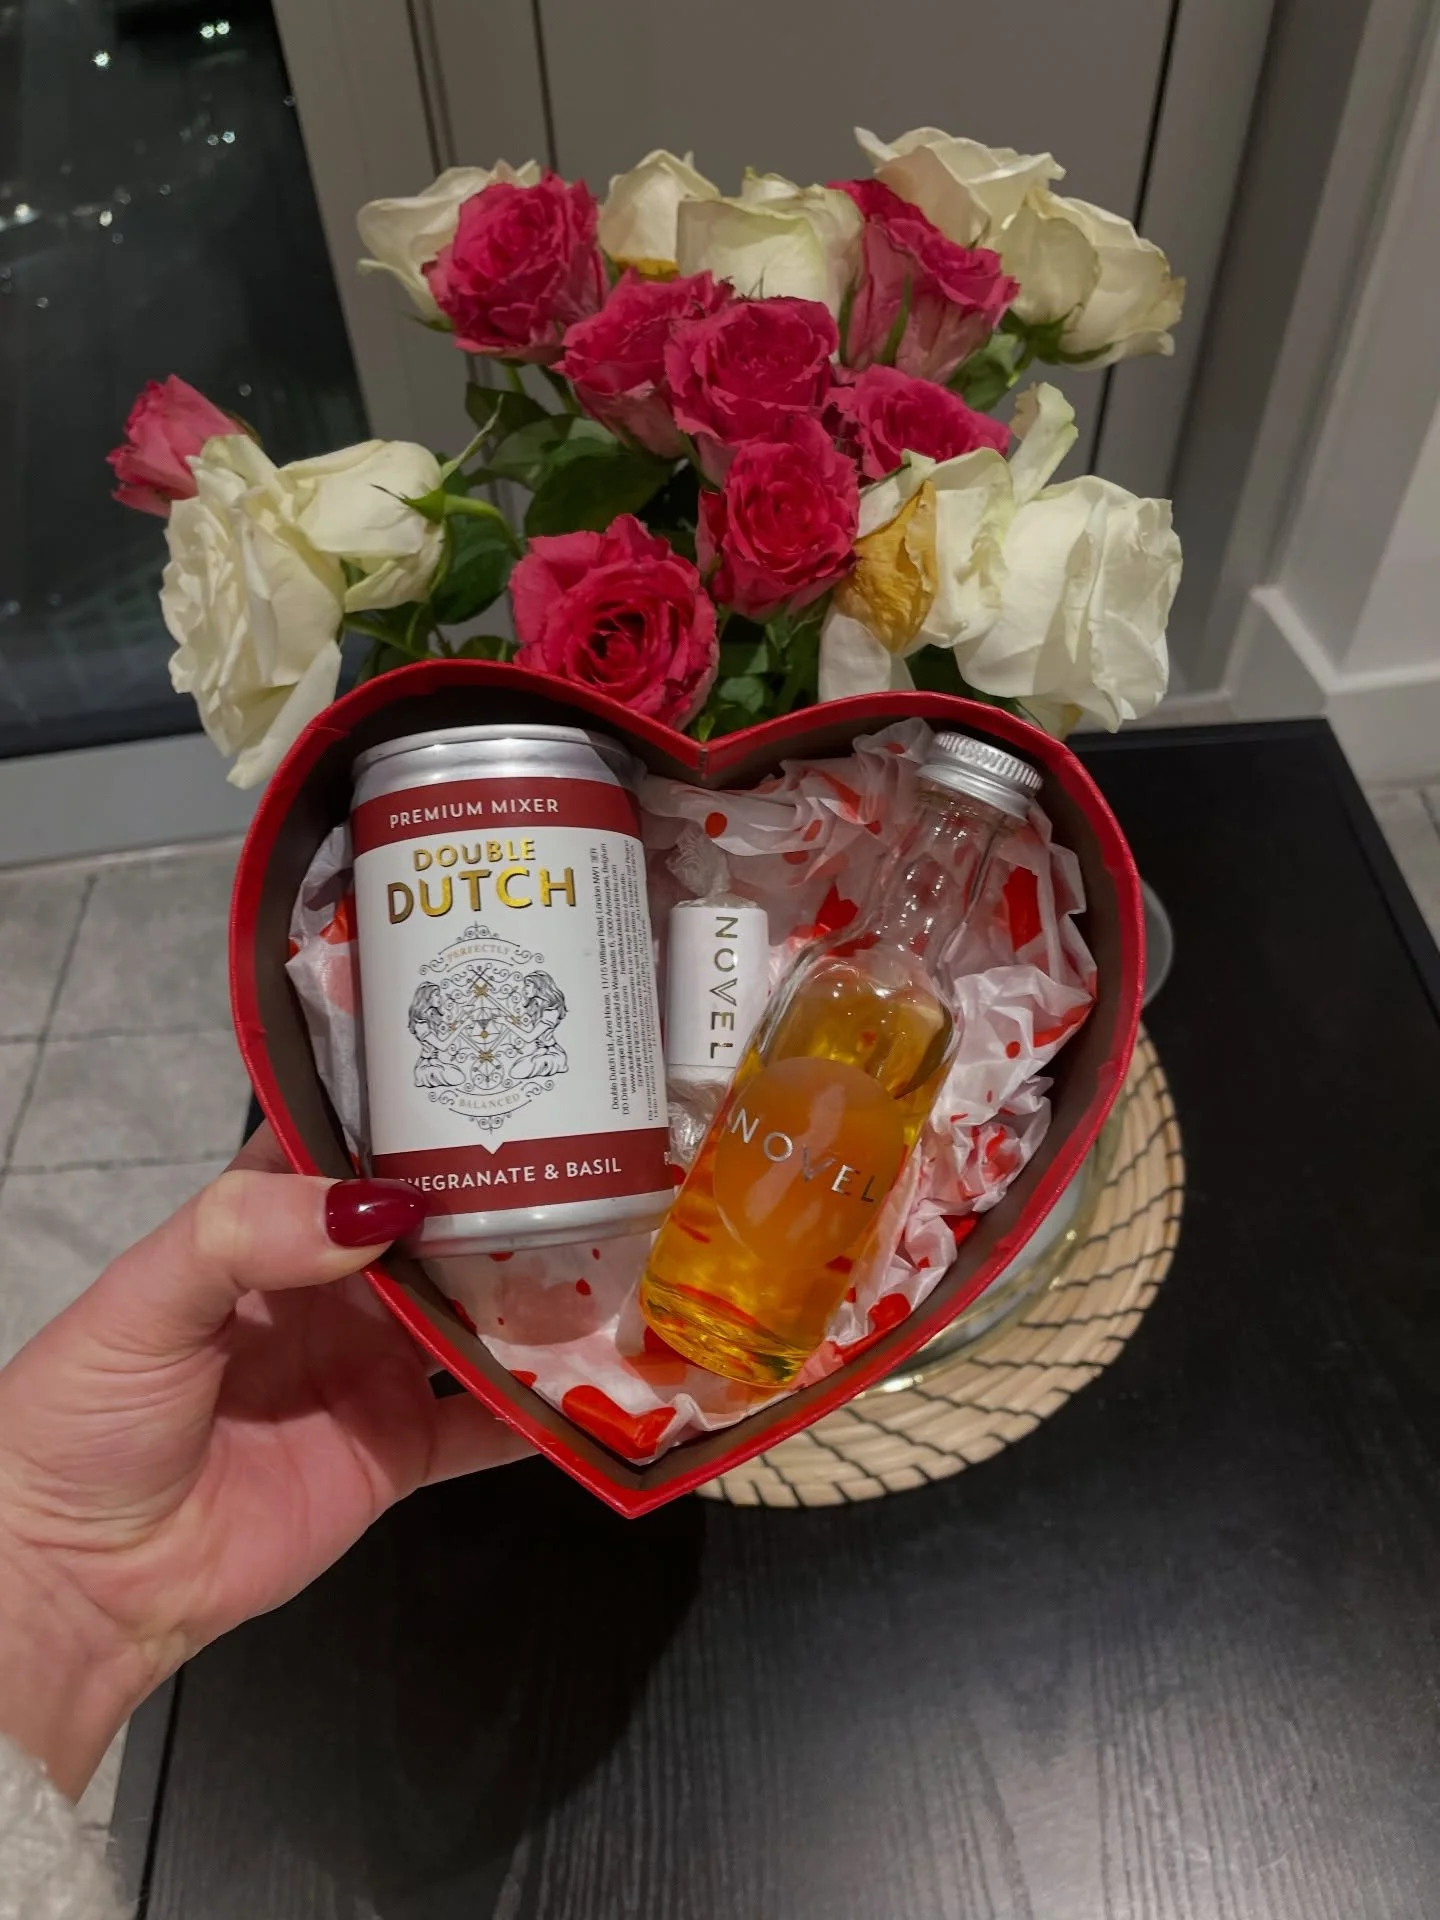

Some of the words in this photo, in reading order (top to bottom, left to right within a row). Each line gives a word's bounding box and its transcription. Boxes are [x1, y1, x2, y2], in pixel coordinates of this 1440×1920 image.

[389, 802, 483, 828] PREMIUM
[491, 798, 559, 814] MIXER
[412, 838, 536, 872] DOUBLE
[386, 866, 577, 925] DUTCH
[709, 916, 738, 1060] NOVEL
[459, 1092, 520, 1109] BALANCED
[545, 1164, 560, 1180] &
[567, 1156, 622, 1177] BASIL
[732, 1107, 875, 1203] NOVEL
